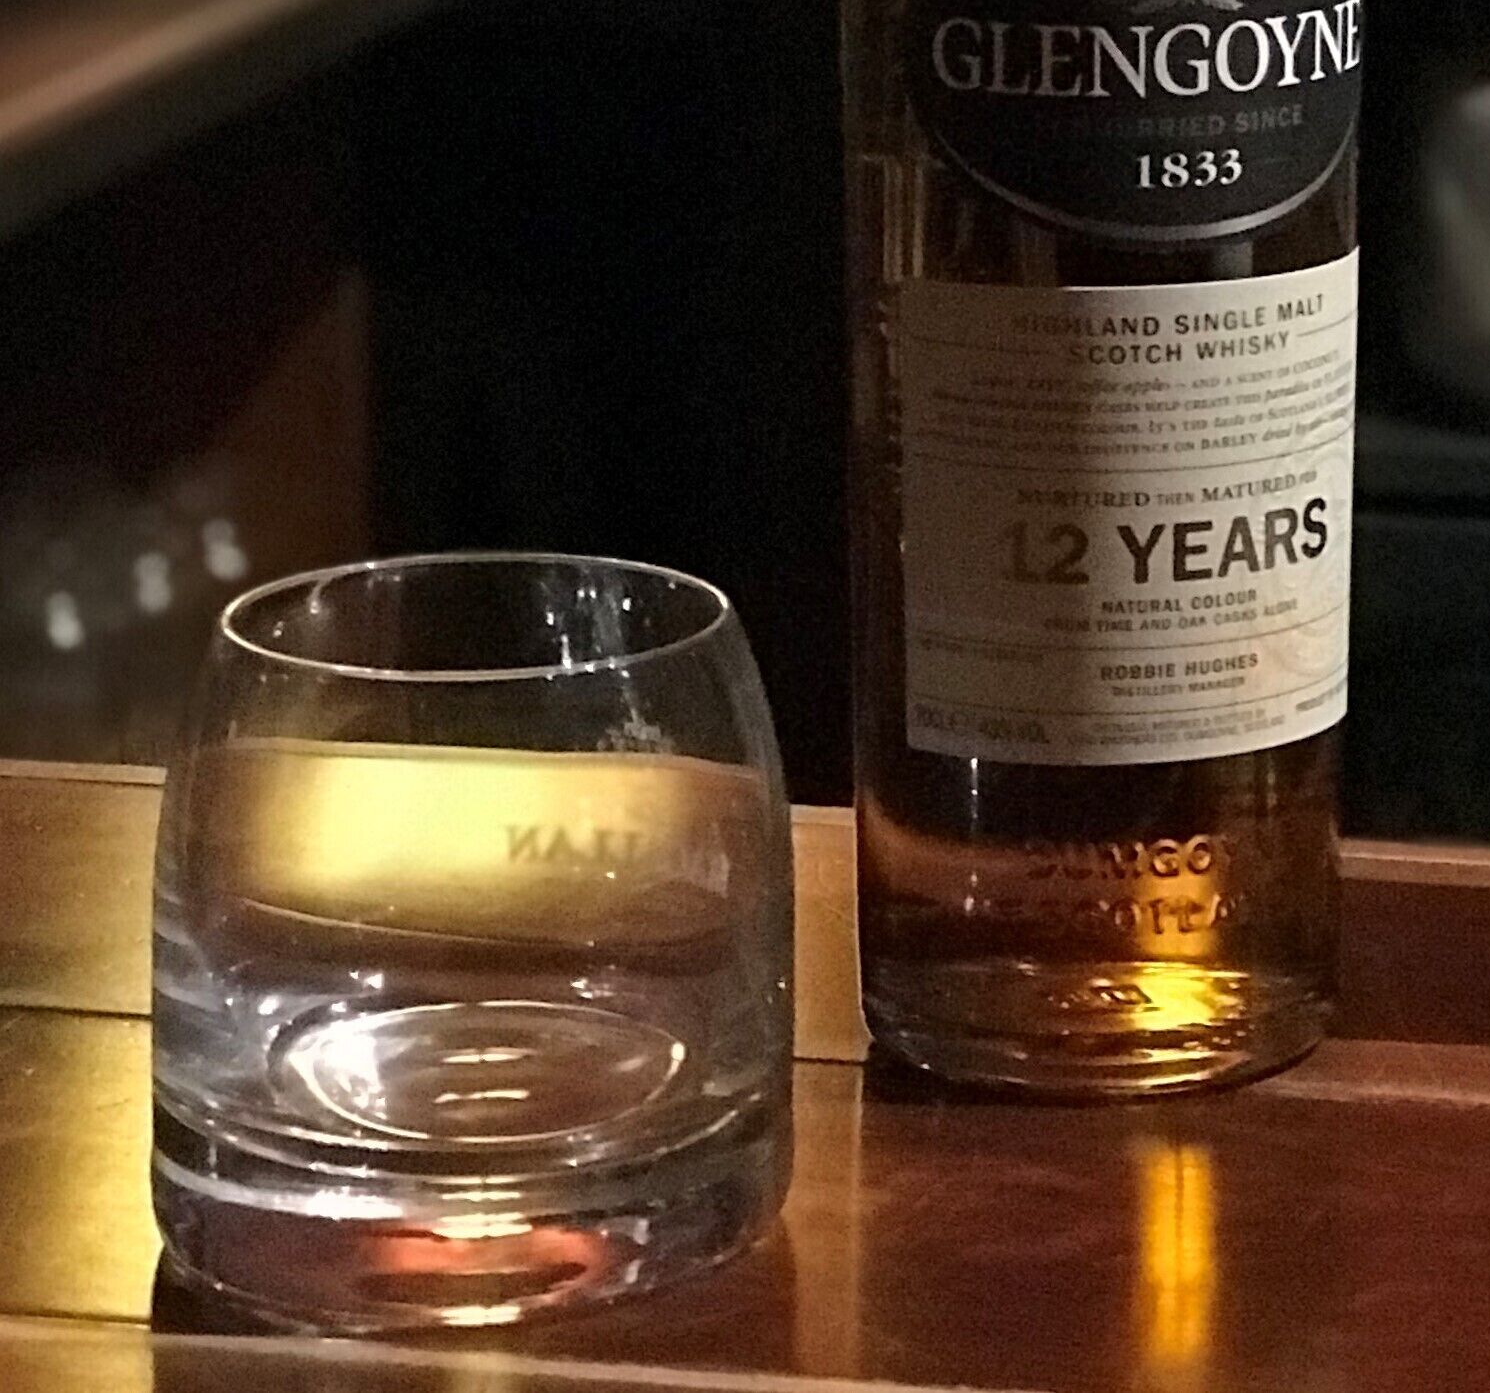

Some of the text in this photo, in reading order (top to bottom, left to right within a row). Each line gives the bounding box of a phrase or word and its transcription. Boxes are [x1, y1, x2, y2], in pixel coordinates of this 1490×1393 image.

[1235, 104, 1302, 133] SINCE
[1137, 148, 1243, 188] 1833
[1175, 307, 1266, 335] SINGLE
[1278, 293, 1324, 322] MALT
[1069, 331, 1290, 365] SCOTCH WHISKY
[1201, 433, 1257, 450] BARLEY
[1157, 492, 1195, 505] THEN
[1202, 474, 1296, 503] MATURED
[1001, 497, 1327, 585] 12 YEARS
[1102, 589, 1257, 614] NATURAL COLOUR
[1139, 617, 1171, 631] AND
[1101, 653, 1258, 681] ROBBIE HUGHES
